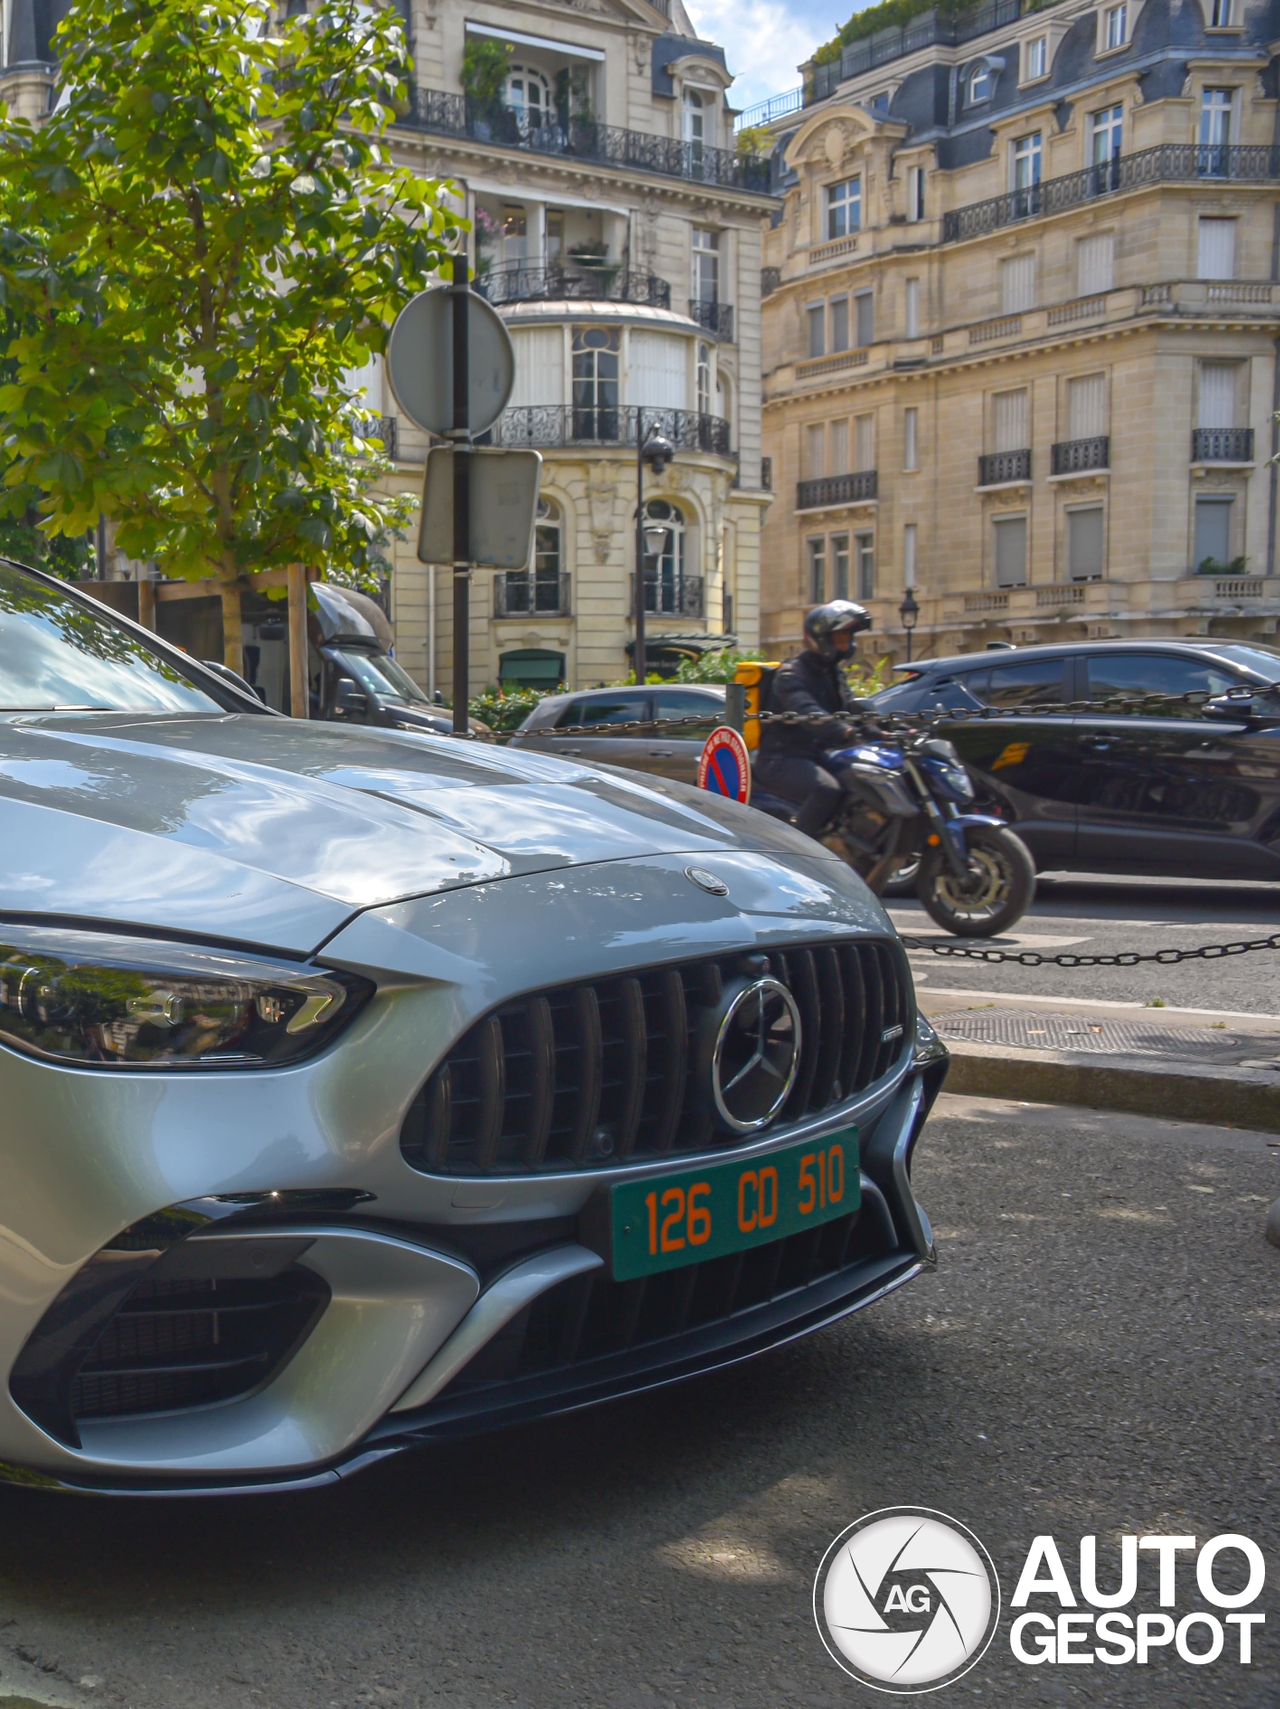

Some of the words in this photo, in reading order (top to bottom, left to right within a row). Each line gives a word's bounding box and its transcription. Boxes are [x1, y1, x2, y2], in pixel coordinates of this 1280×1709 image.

[645, 1182, 712, 1255] 126
[737, 1166, 778, 1233] CD
[798, 1144, 845, 1215] 510
